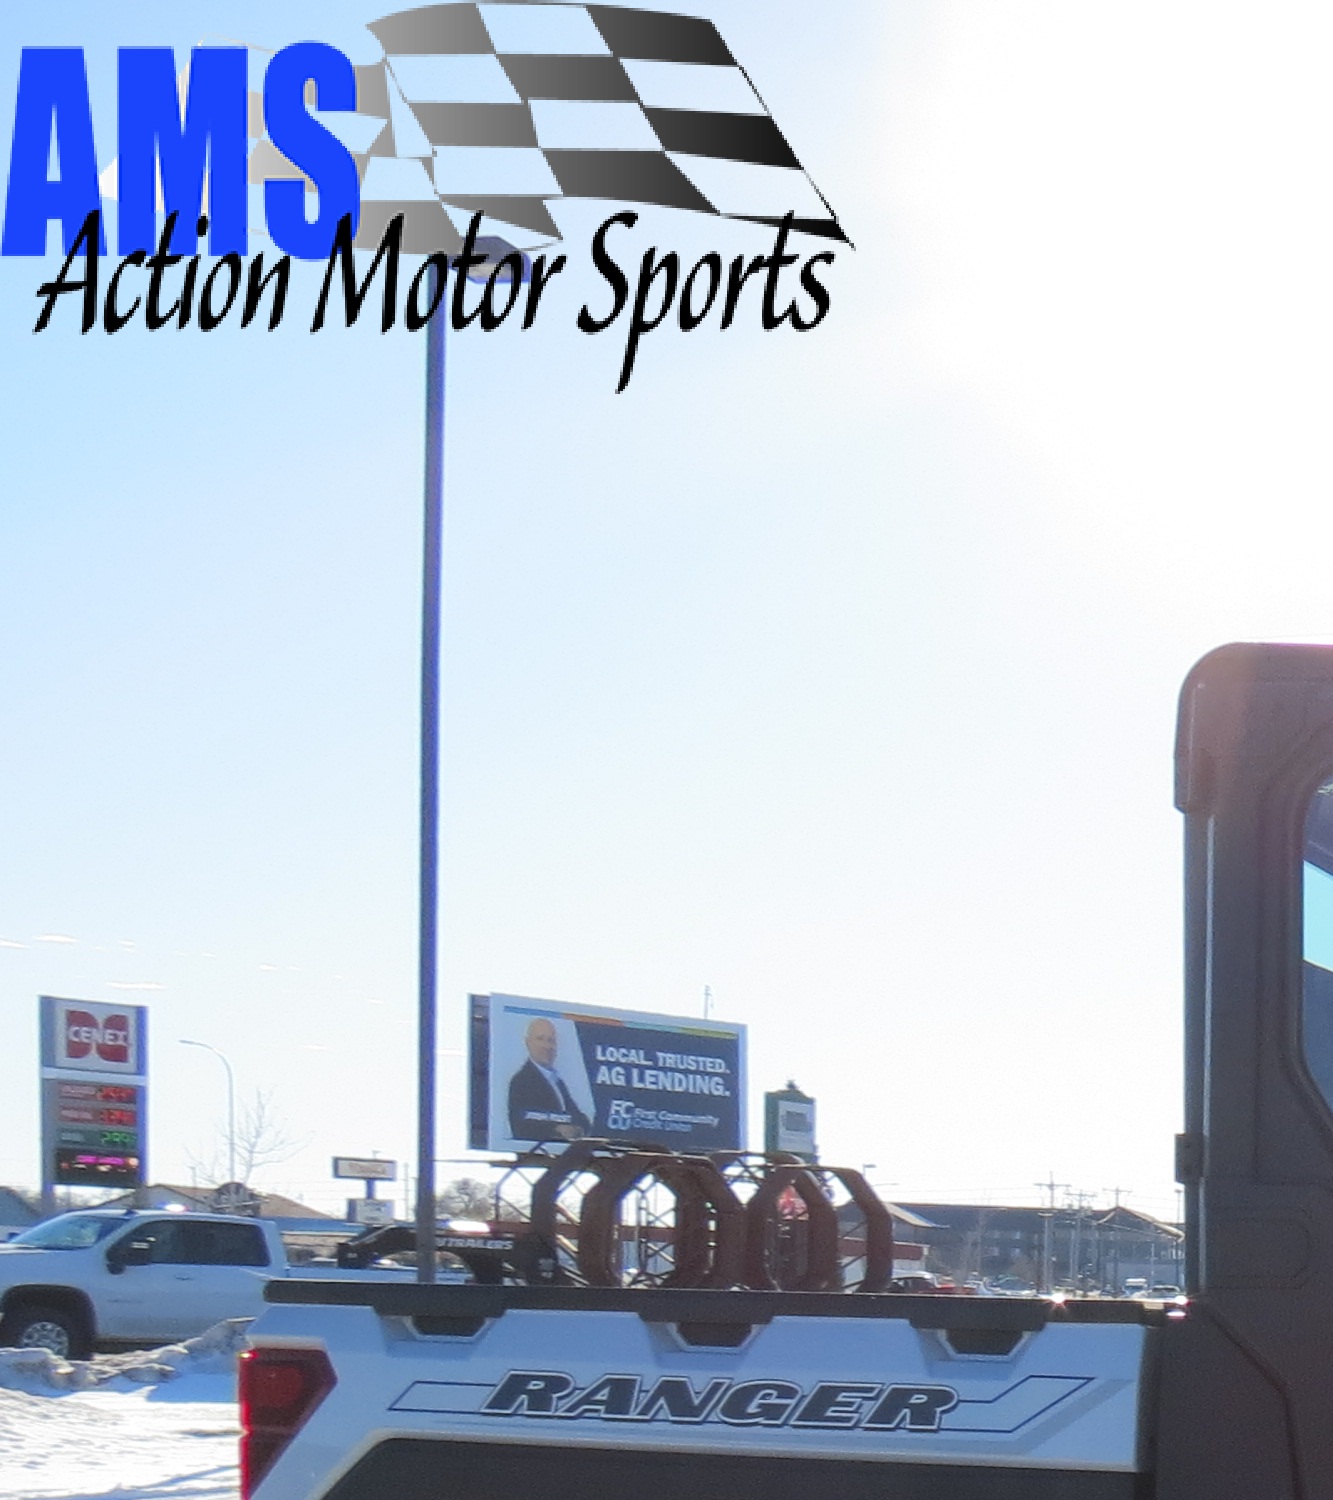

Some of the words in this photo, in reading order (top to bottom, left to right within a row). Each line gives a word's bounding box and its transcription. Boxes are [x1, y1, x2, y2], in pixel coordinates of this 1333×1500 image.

[68, 1026, 129, 1046] CENEX
[595, 1044, 654, 1067] LOCAL.
[656, 1051, 731, 1074] TRUSTED.
[596, 1064, 627, 1087] AG
[631, 1067, 731, 1097] LENDING.
[610, 1100, 635, 1118] FC
[479, 1367, 959, 1432] RANGER
